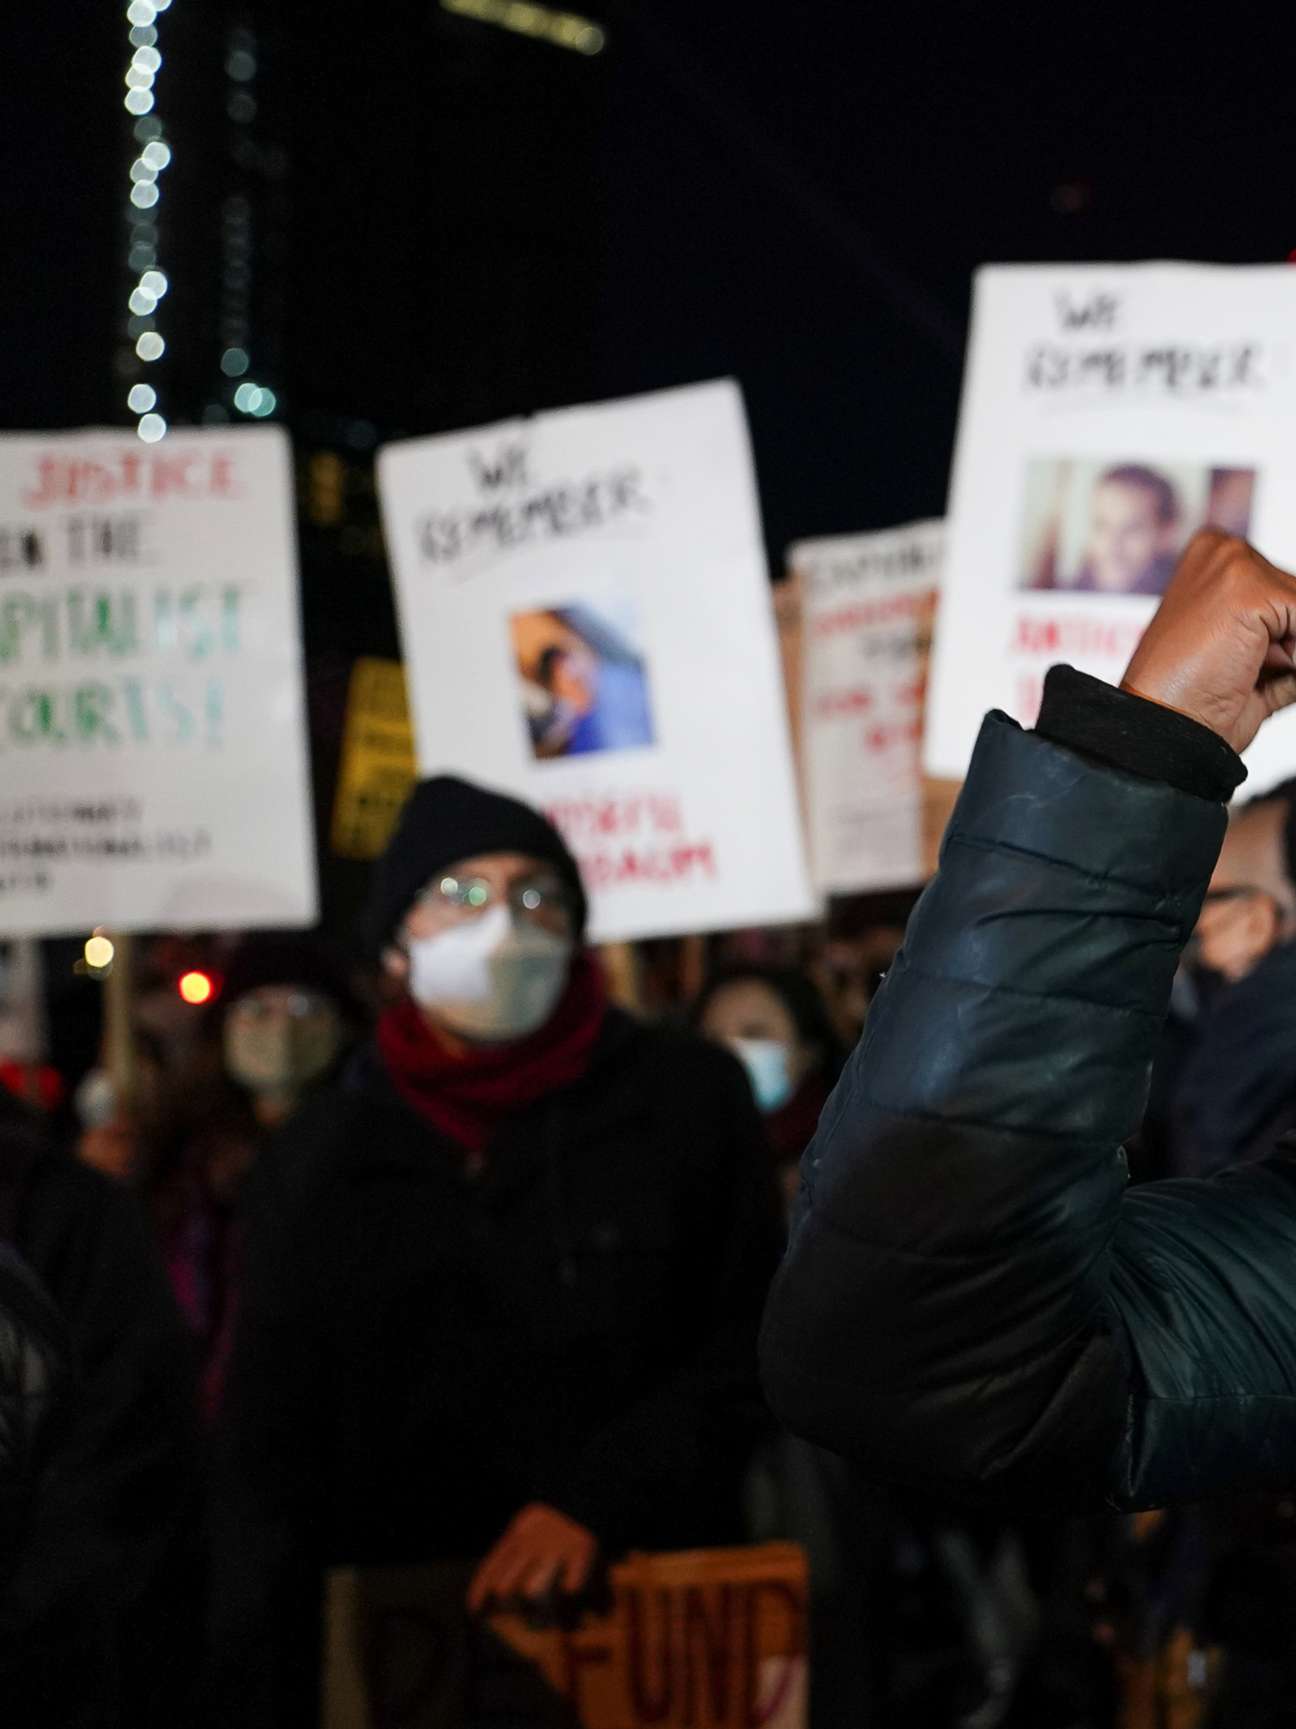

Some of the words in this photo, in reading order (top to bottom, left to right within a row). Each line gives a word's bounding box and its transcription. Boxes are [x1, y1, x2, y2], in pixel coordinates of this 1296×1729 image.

[1056, 289, 1124, 333] WE
[23, 446, 238, 509] JUSTICE
[66, 512, 150, 566] THE
[0, 583, 242, 660] PITALIST
[0, 673, 224, 751] OURTS!
